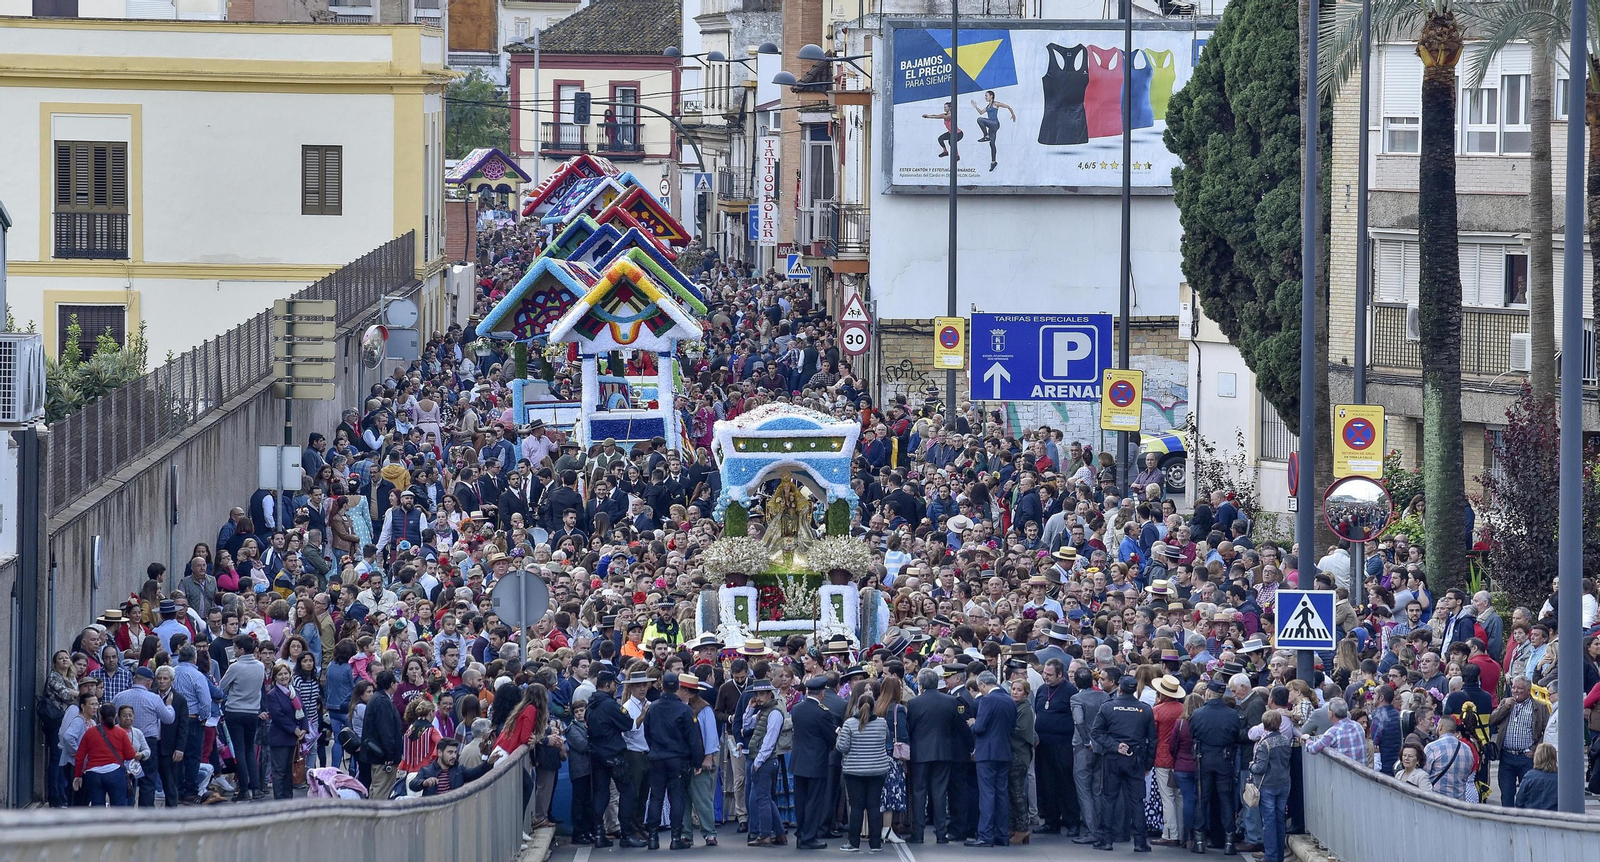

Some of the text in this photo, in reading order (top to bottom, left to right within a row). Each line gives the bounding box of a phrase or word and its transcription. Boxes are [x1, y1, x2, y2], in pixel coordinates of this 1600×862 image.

[900, 55, 943, 70] BAJAMOS
[906, 64, 952, 80] EL PRECIO
[905, 74, 952, 88] PARA SIEMPR
[1078, 162, 1096, 170] 4,6/5
[846, 334, 864, 345] 30
[1053, 332, 1092, 376] P
[1030, 385, 1102, 398] ARENAL
